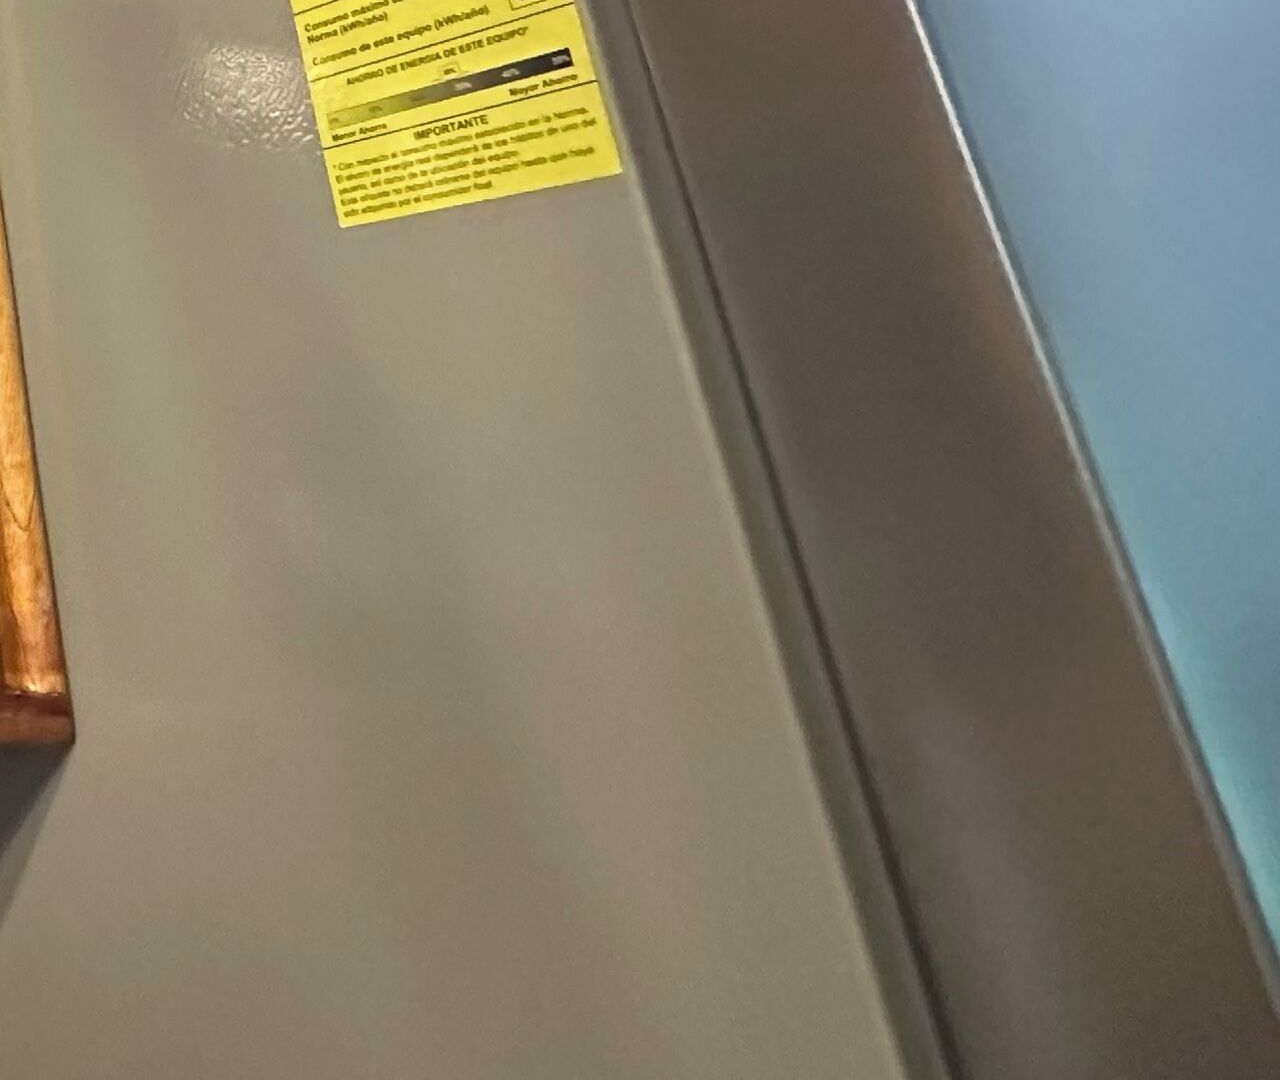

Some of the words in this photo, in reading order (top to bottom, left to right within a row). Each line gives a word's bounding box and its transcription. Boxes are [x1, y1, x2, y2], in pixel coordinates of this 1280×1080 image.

[304, 13, 349, 33] Consumo
[307, 29, 338, 44] Norma
[312, 47, 357, 66] Consumo
[359, 42, 371, 52] de
[373, 35, 394, 48] este
[397, 24, 433, 41] equipo
[346, 68, 384, 86] AHORRO
[385, 64, 398, 75] DE
[443, 47, 458, 58] DE
[459, 39, 485, 53] ESTE
[508, 83, 539, 96] Mayor
[332, 130, 356, 142] Menor
[413, 114, 488, 141] IMPORTANTE
